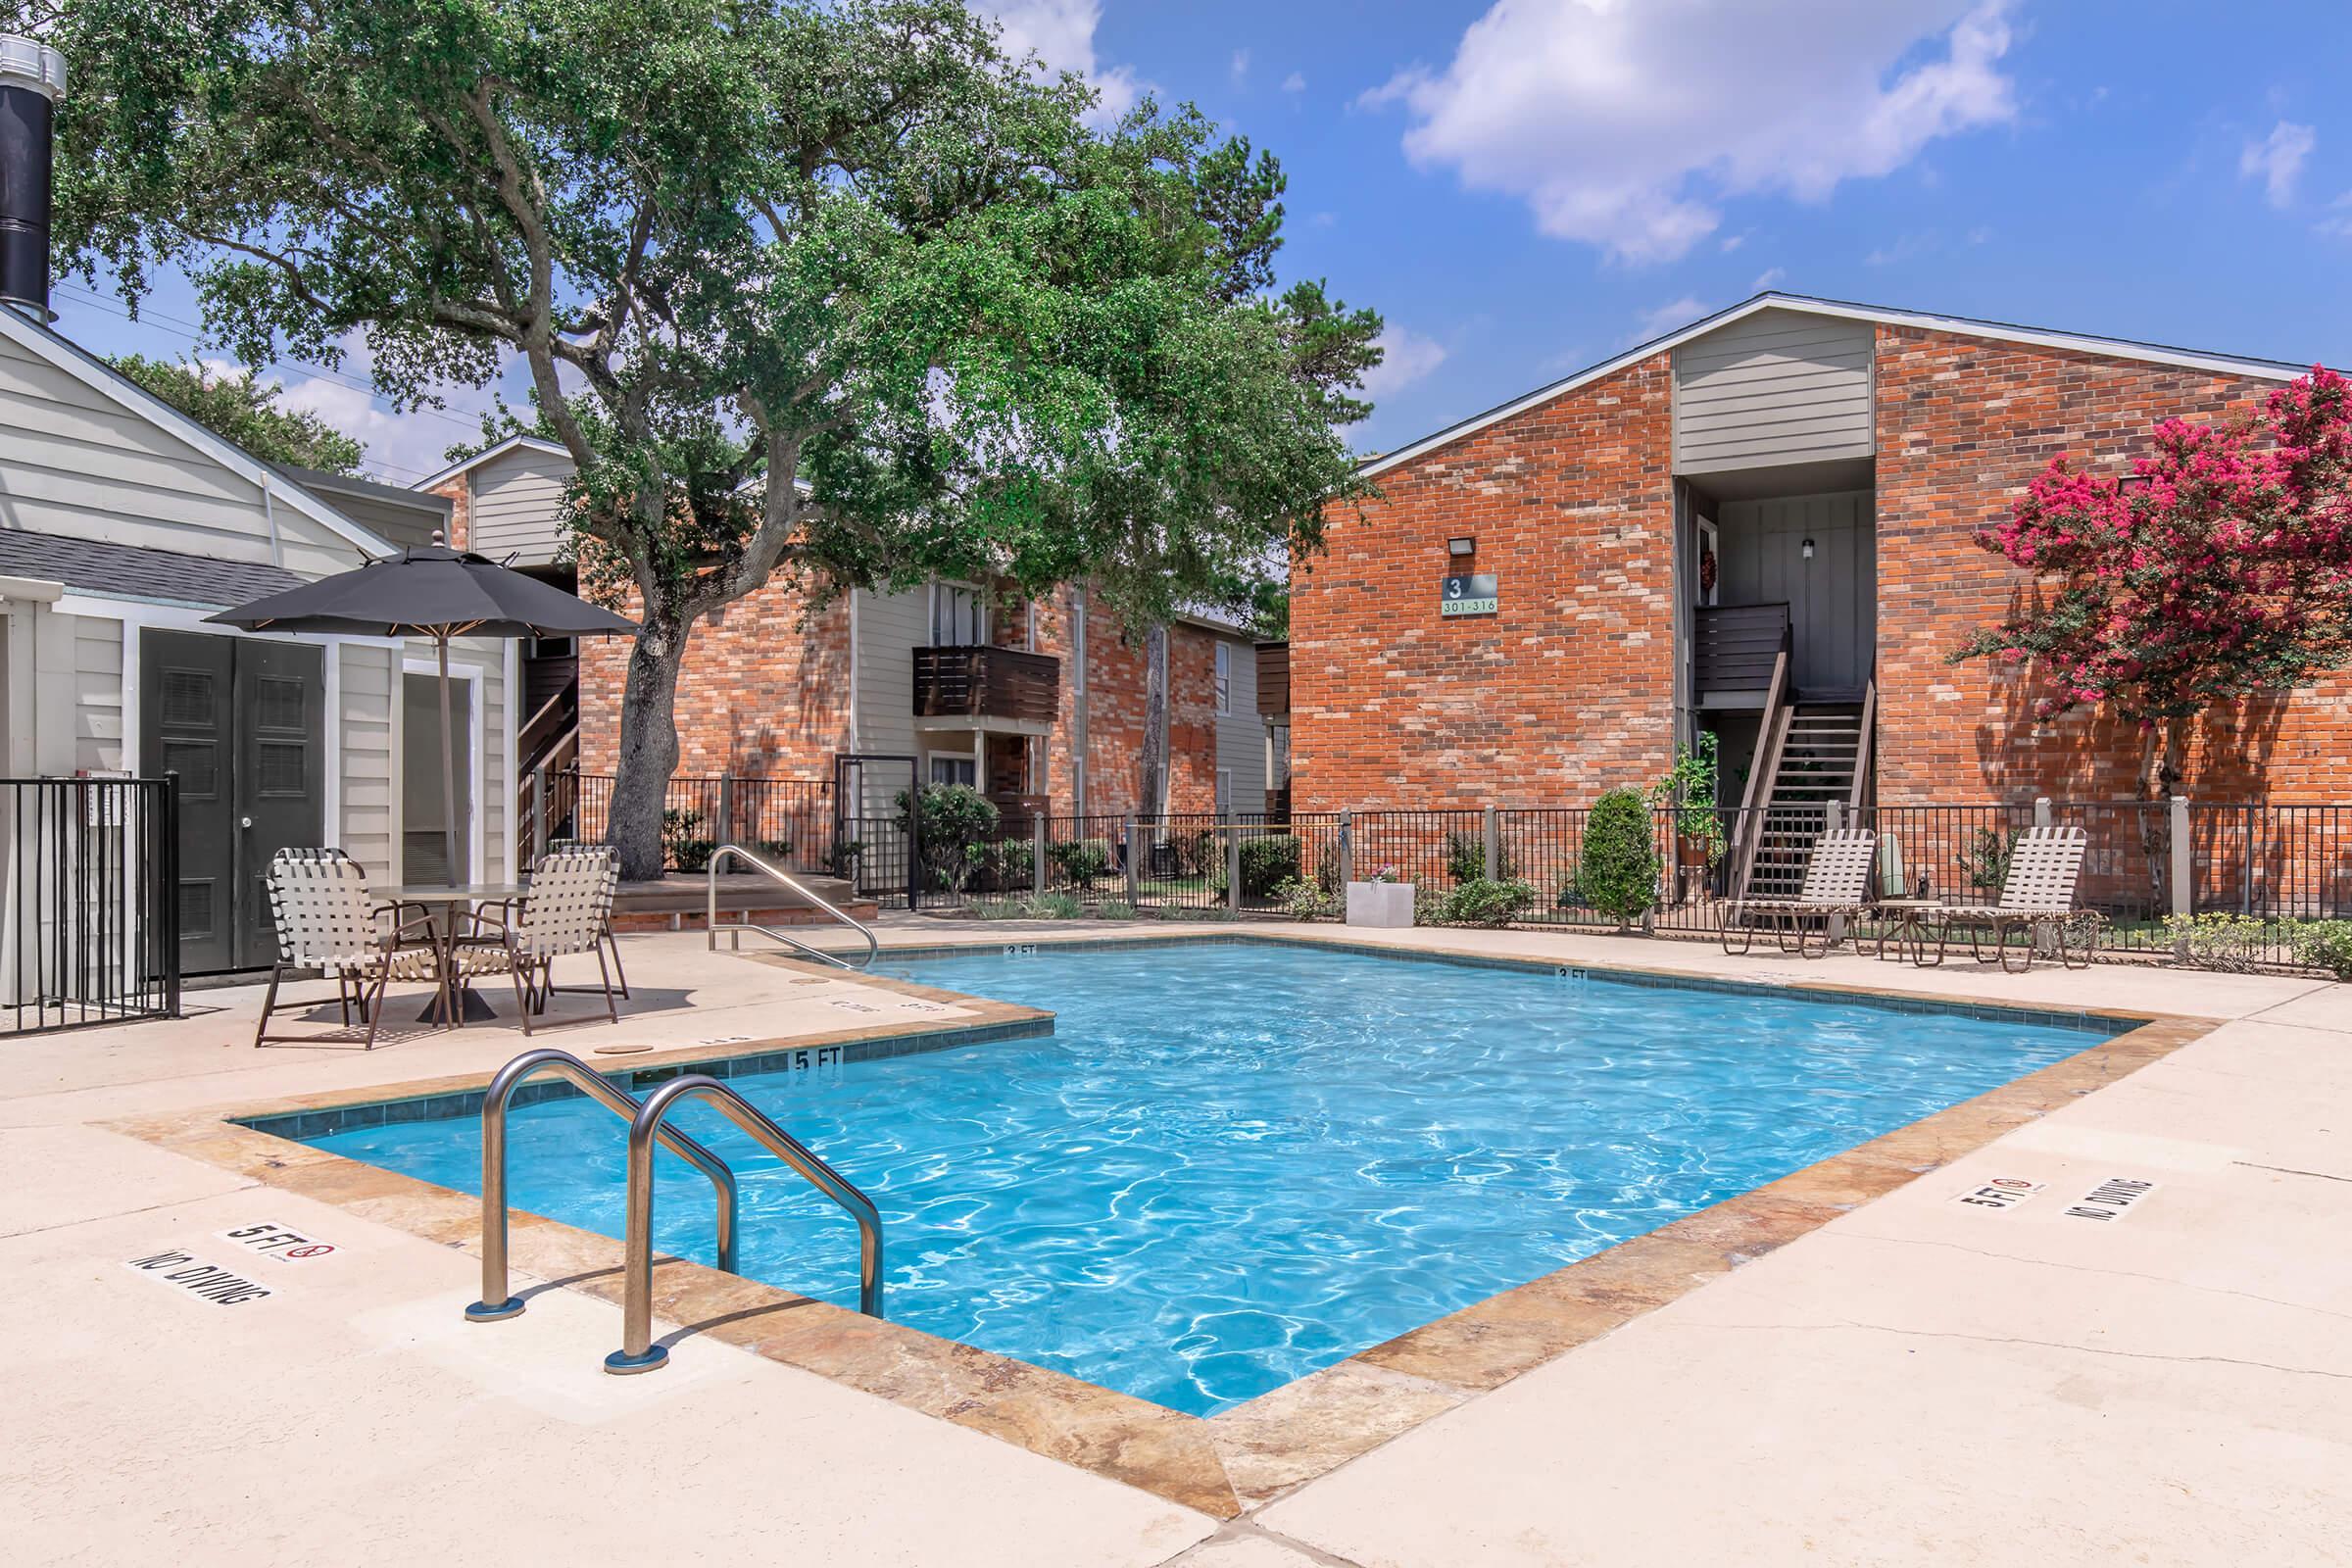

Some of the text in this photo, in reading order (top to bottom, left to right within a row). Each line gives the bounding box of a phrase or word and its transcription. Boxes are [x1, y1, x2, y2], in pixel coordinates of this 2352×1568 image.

[1449, 579, 1461, 599] 3
[1444, 601, 1494, 612] 301-316
[796, 1047, 841, 1069] 5 FT
[1960, 1198, 2006, 1207] 5
[1975, 1187, 2026, 1202] FT
[2064, 1178, 2153, 1221] NO DIVING
[226, 1224, 309, 1250] 5 FT
[128, 1251, 271, 1305] NO DIVING
